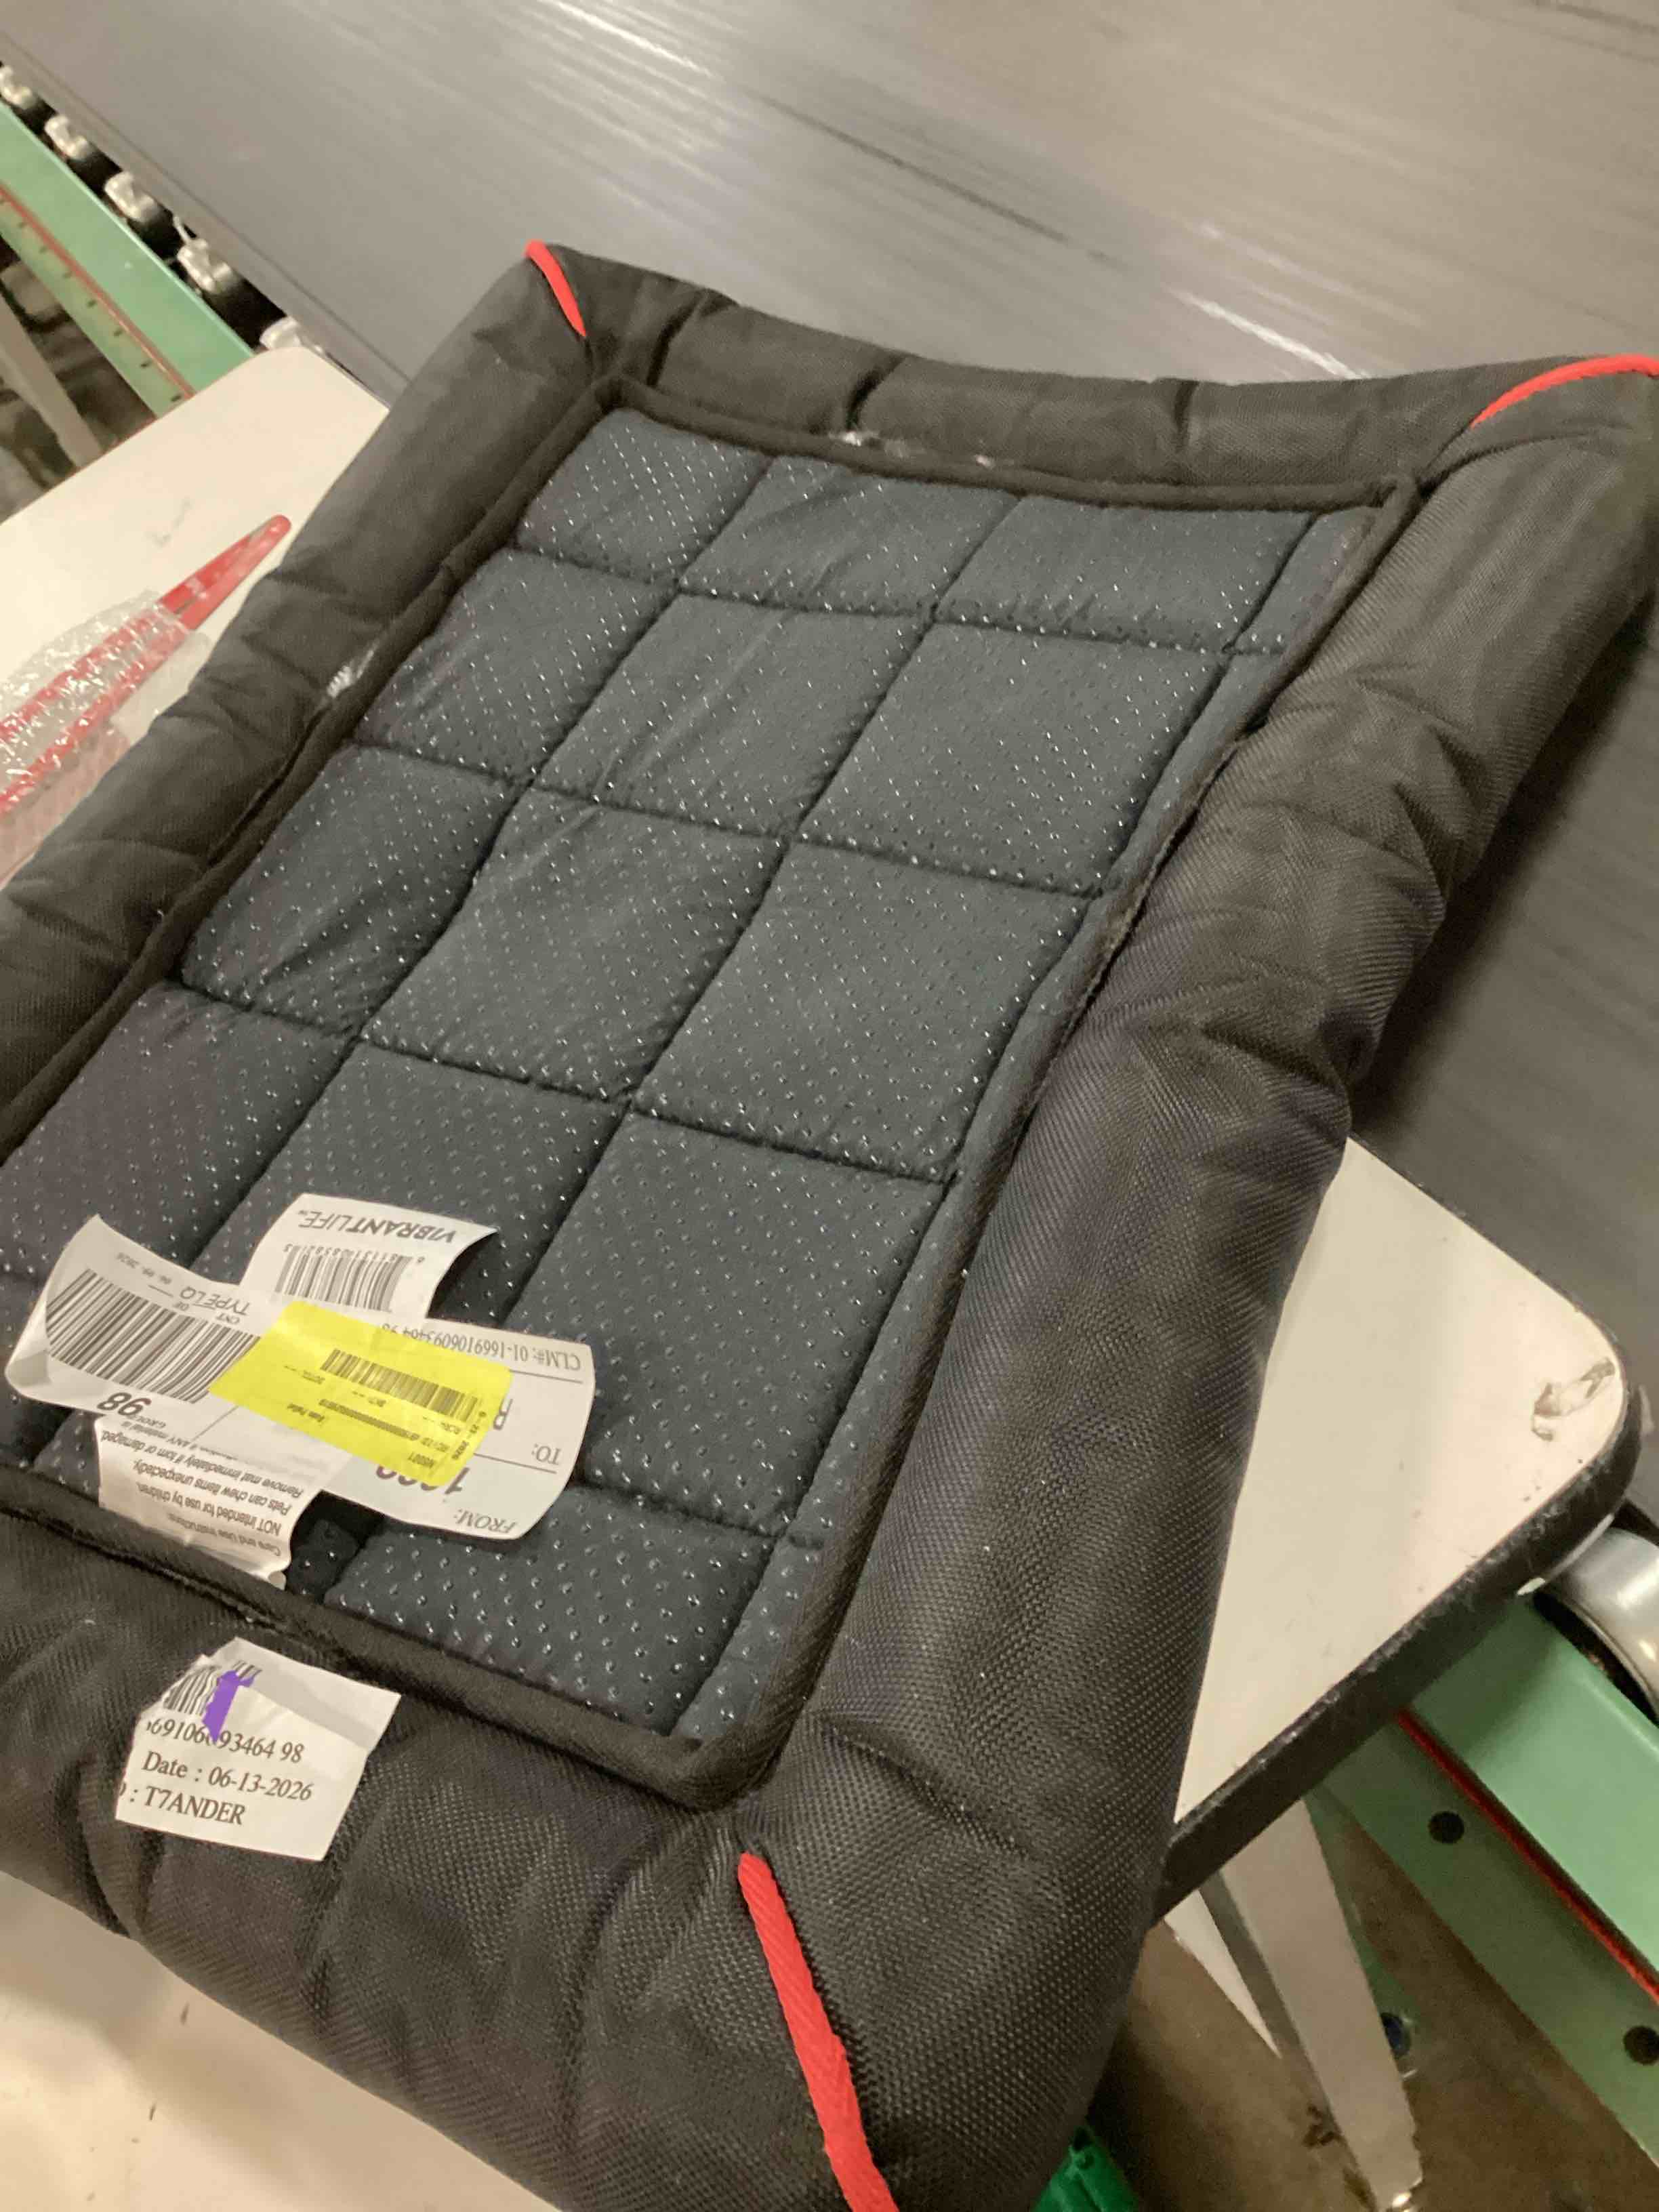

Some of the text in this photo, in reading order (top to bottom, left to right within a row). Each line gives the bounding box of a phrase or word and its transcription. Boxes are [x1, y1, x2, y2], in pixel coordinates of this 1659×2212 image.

[204, 1294, 251, 1316] TYPE
[532, 1349, 581, 1372] CLM#:
[96, 1392, 151, 1416] 98
[144, 1445, 158, 1454] or
[531, 1443, 562, 1466] TO:
[184, 1454, 241, 1481] immediately
[192, 1478, 222, 1496] items
[240, 1472, 263, 1486] mat
[221, 1486, 249, 1501] chew
[262, 1478, 304, 1498] Remove
[171, 1492, 184, 1507] by
[184, 1497, 201, 1510] use
[249, 1494, 268, 1506] can
[268, 1499, 292, 1516] Pets
[201, 1503, 215, 1517] for
[255, 1519, 282, 1536] NOT
[453, 1509, 518, 1534] FROM:
[238, 1534, 255, 1548] and
[254, 1540, 281, 1557] Care
[146, 1718, 306, 1763] 6910693464 98
[142, 1750, 188, 1779] Date
[207, 1766, 314, 1802] 06-13-2026
[144, 1785, 246, 1826] T7ANDER
